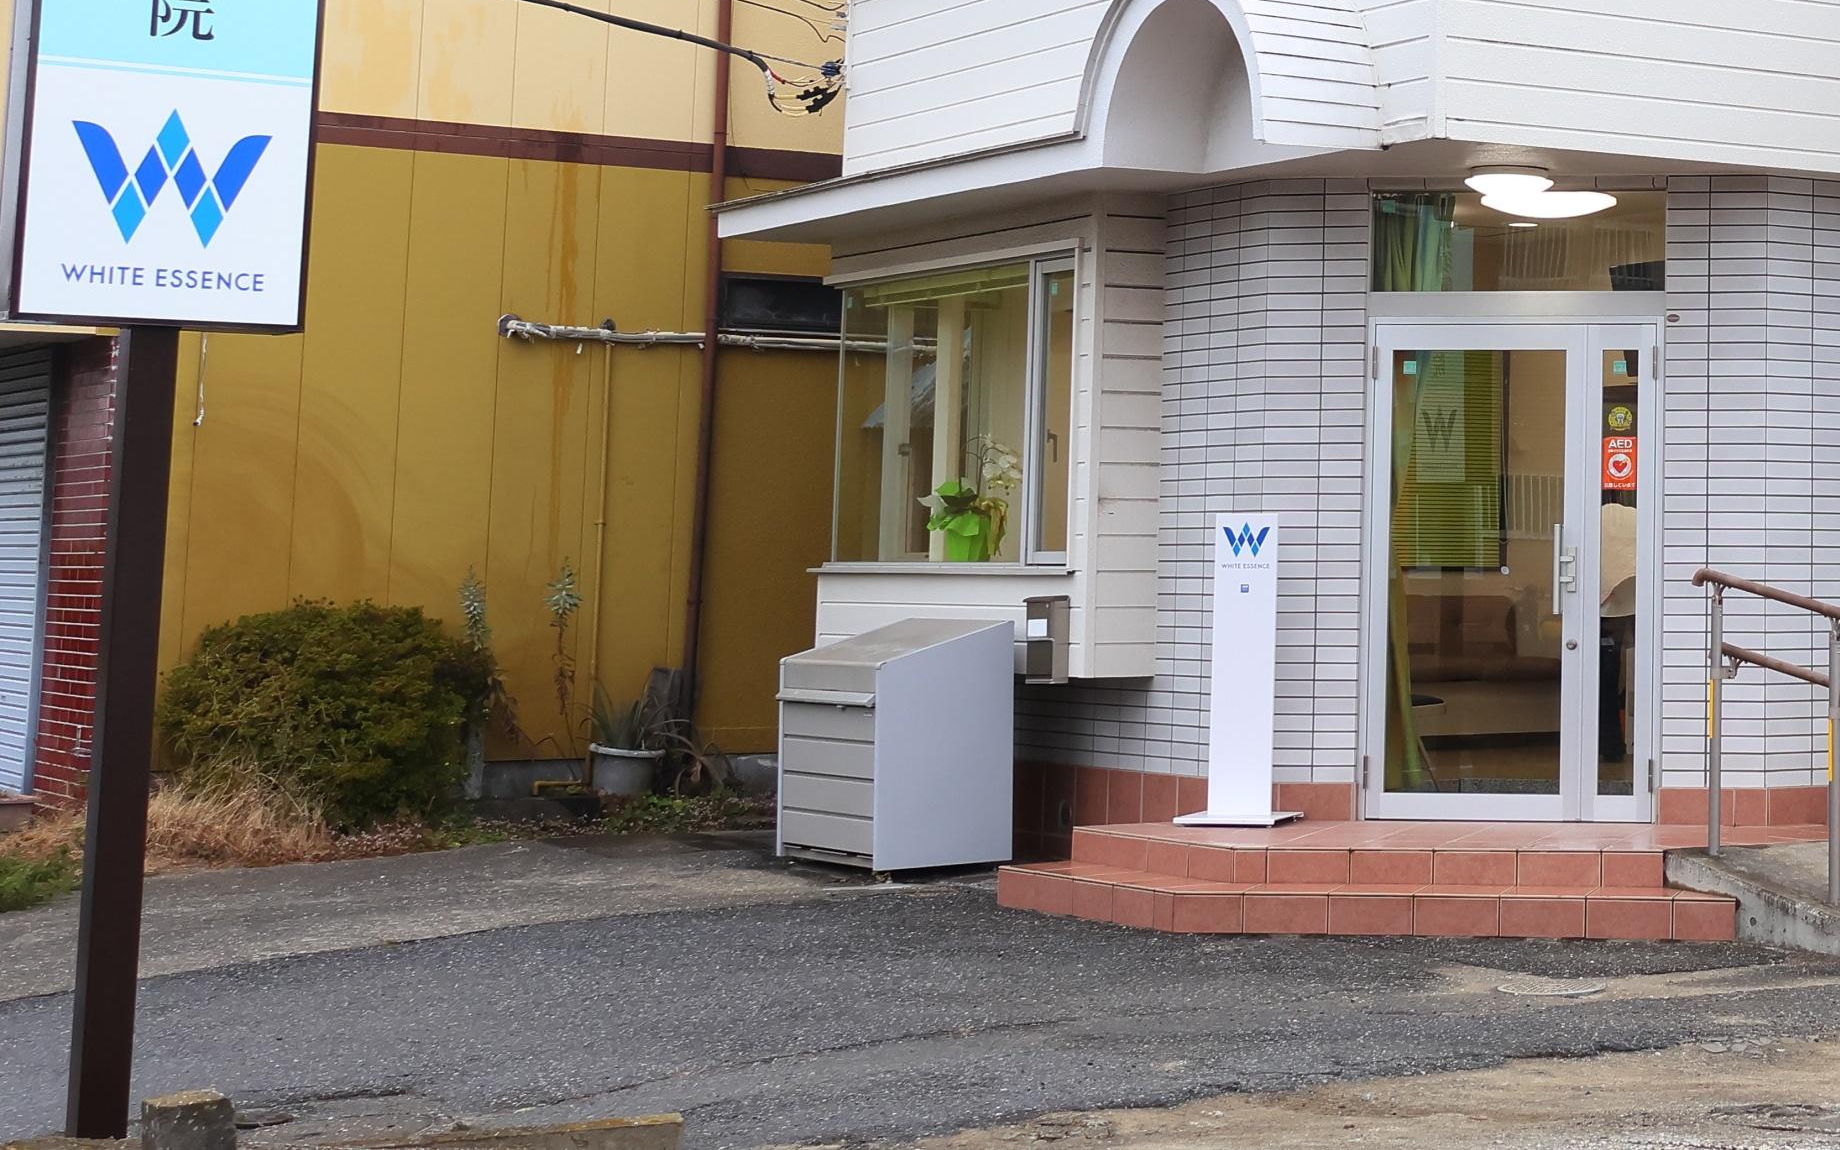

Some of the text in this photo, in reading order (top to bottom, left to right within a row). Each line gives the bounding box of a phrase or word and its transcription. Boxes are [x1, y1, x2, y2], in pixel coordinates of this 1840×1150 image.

[61, 263, 265, 292] WHITE ESSENCE
[1608, 439, 1633, 448] AED
